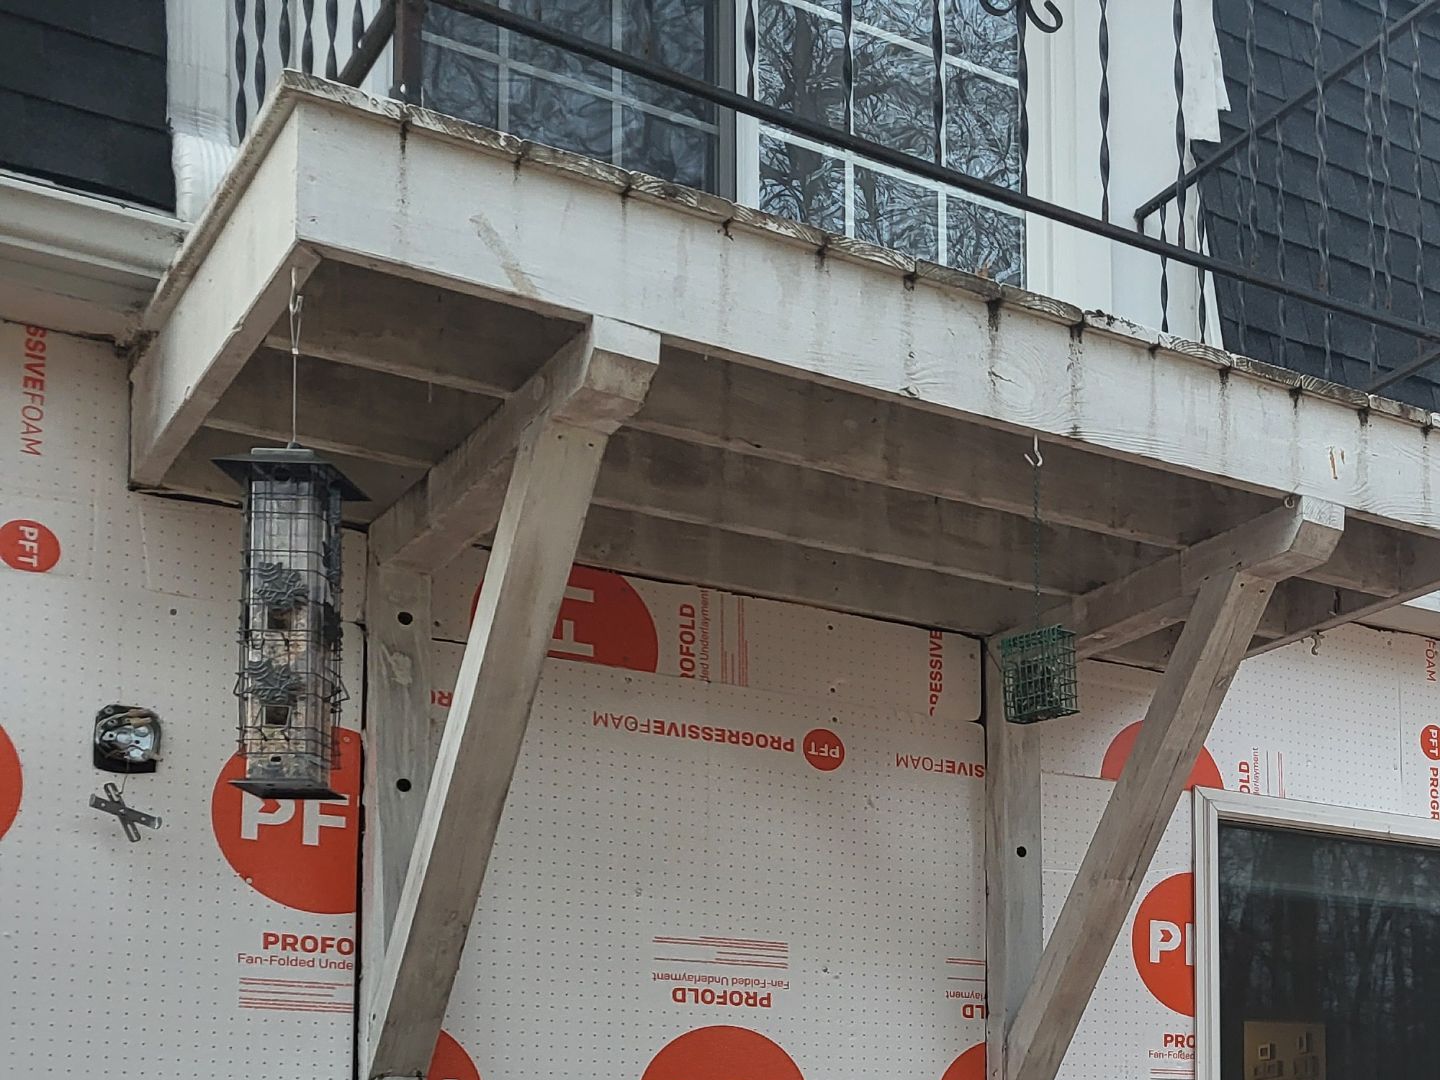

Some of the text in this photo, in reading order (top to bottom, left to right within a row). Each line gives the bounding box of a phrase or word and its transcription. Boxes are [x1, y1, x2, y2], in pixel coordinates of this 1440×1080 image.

[17, 524, 40, 568] PFT
[592, 710, 841, 760] PFT PROGRESSIVEFOAM
[1429, 728, 1440, 757] PFT
[236, 952, 316, 968] Fan-Folded
[652, 971, 790, 989] Fan-Folded Underlayment
[671, 986, 773, 1009] PROFOLD
